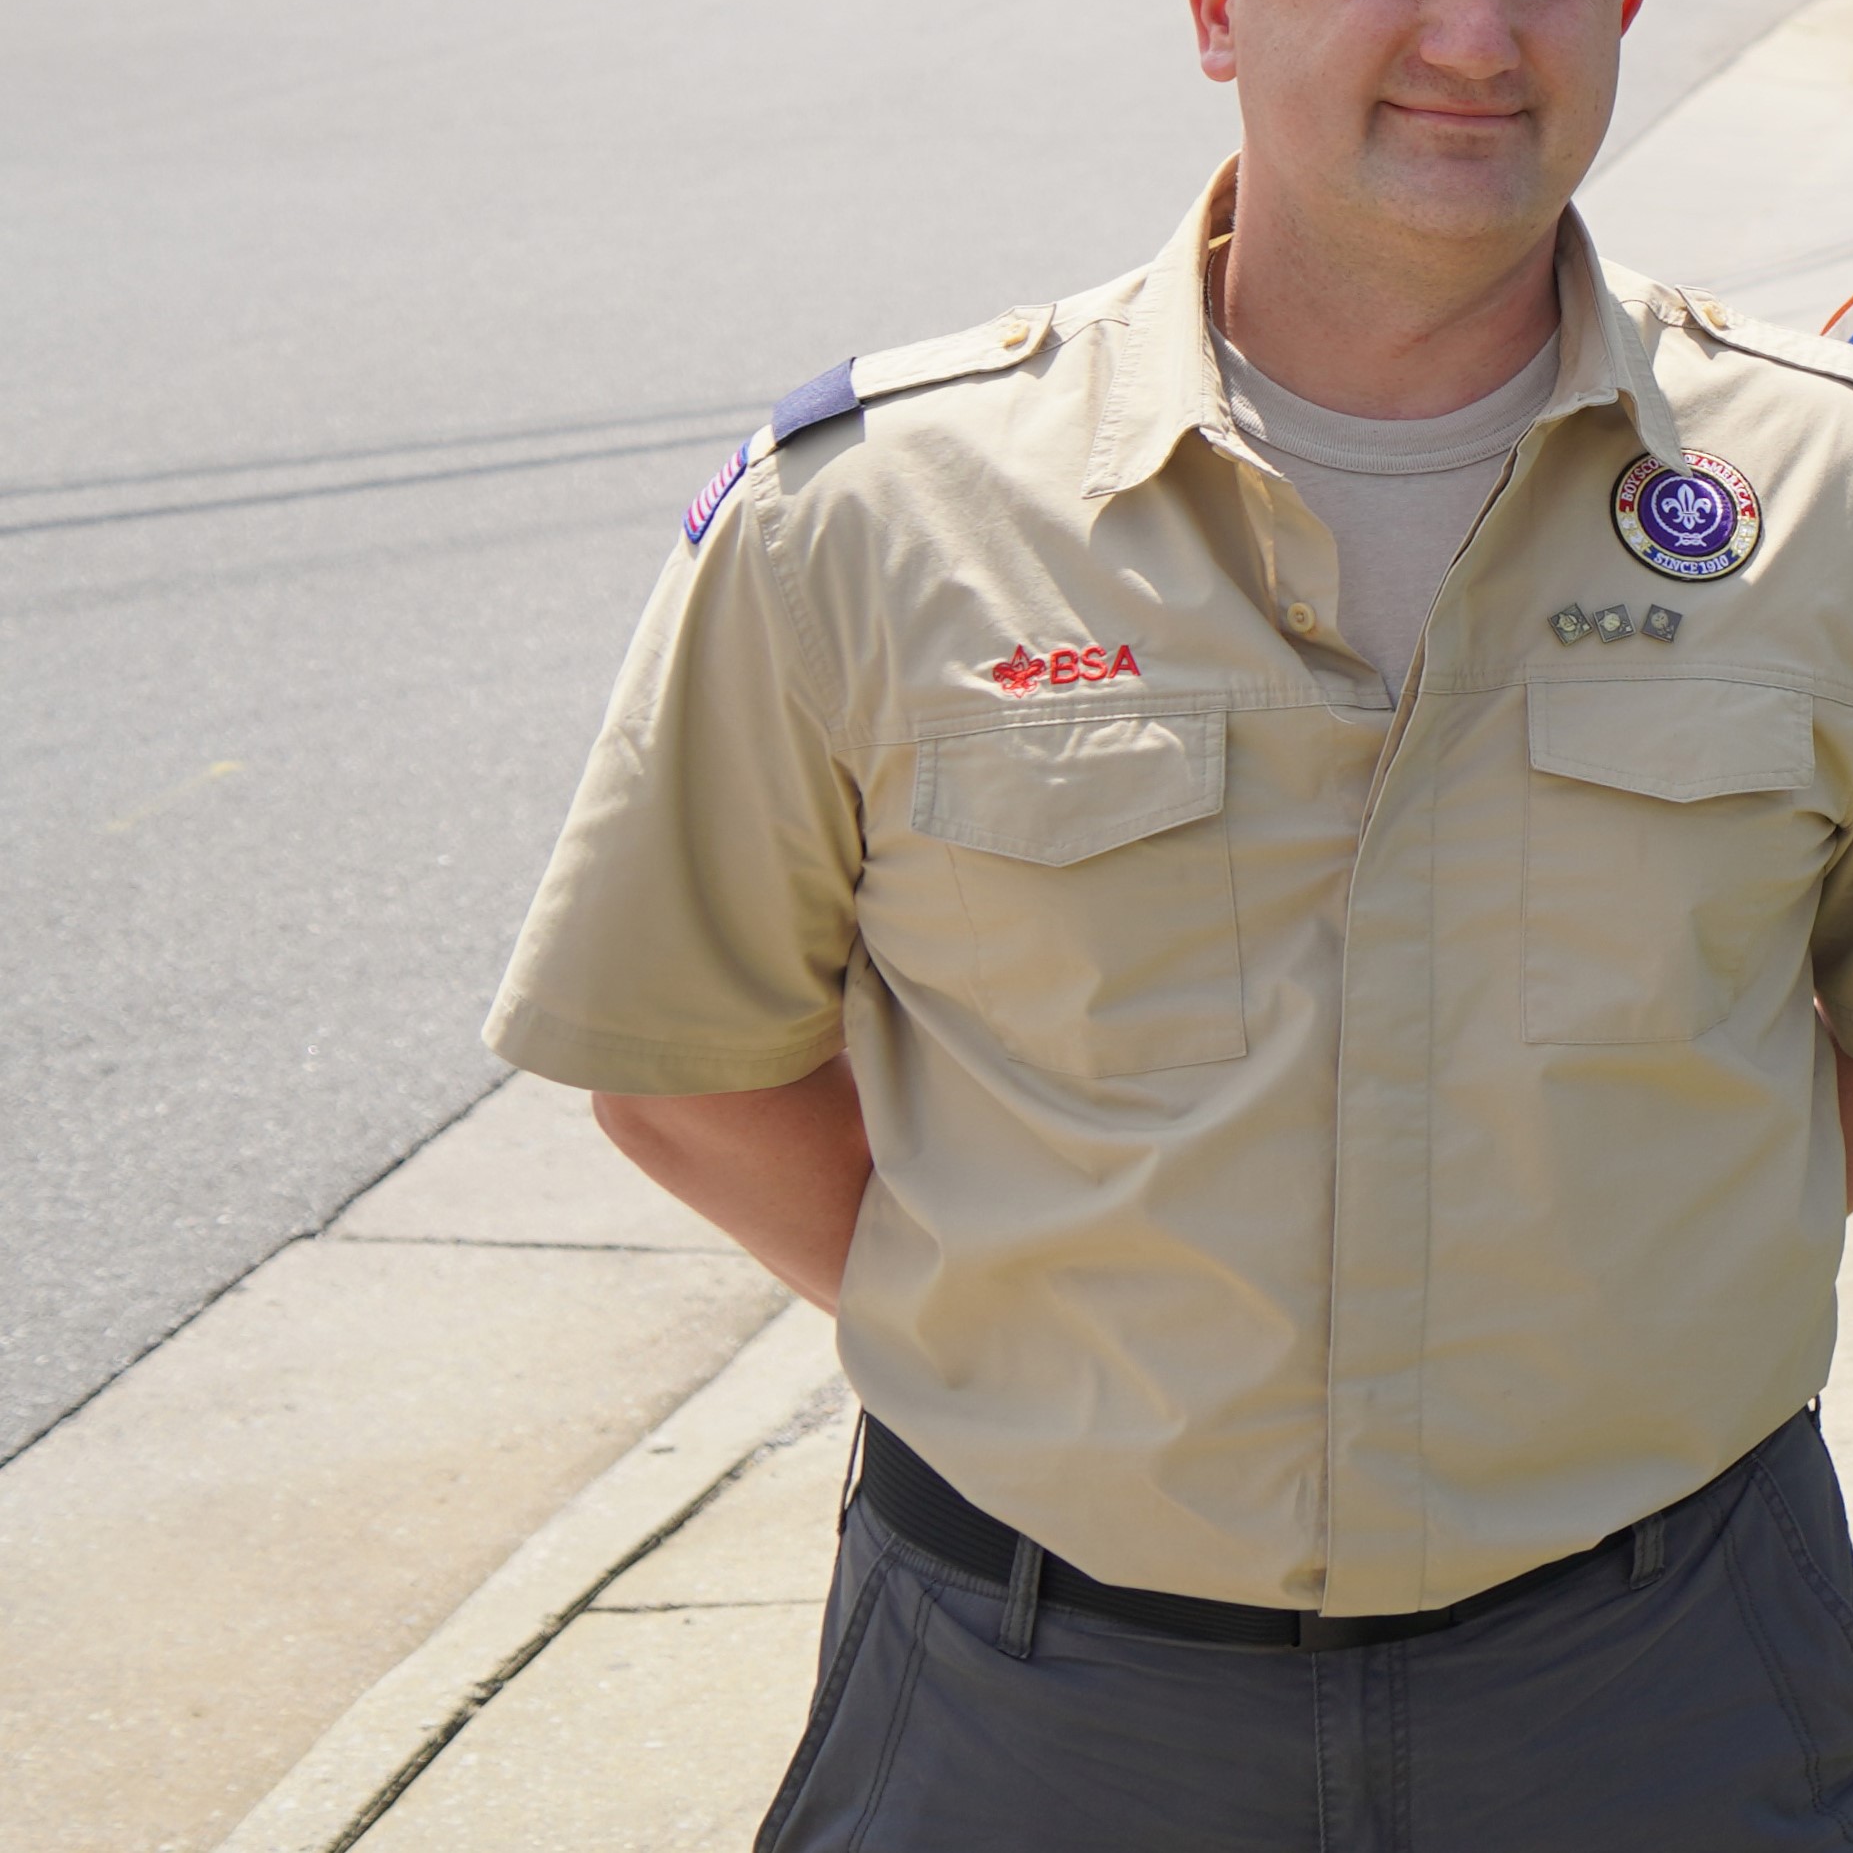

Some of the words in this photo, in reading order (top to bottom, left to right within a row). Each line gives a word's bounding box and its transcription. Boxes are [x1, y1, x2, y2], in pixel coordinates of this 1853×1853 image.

[1621, 475, 1637, 501] BOY
[1698, 458, 1751, 506] AMERICA
[1654, 552, 1698, 574] SINCE
[1699, 555, 1728, 575] 1910
[1049, 644, 1141, 685] BSA
